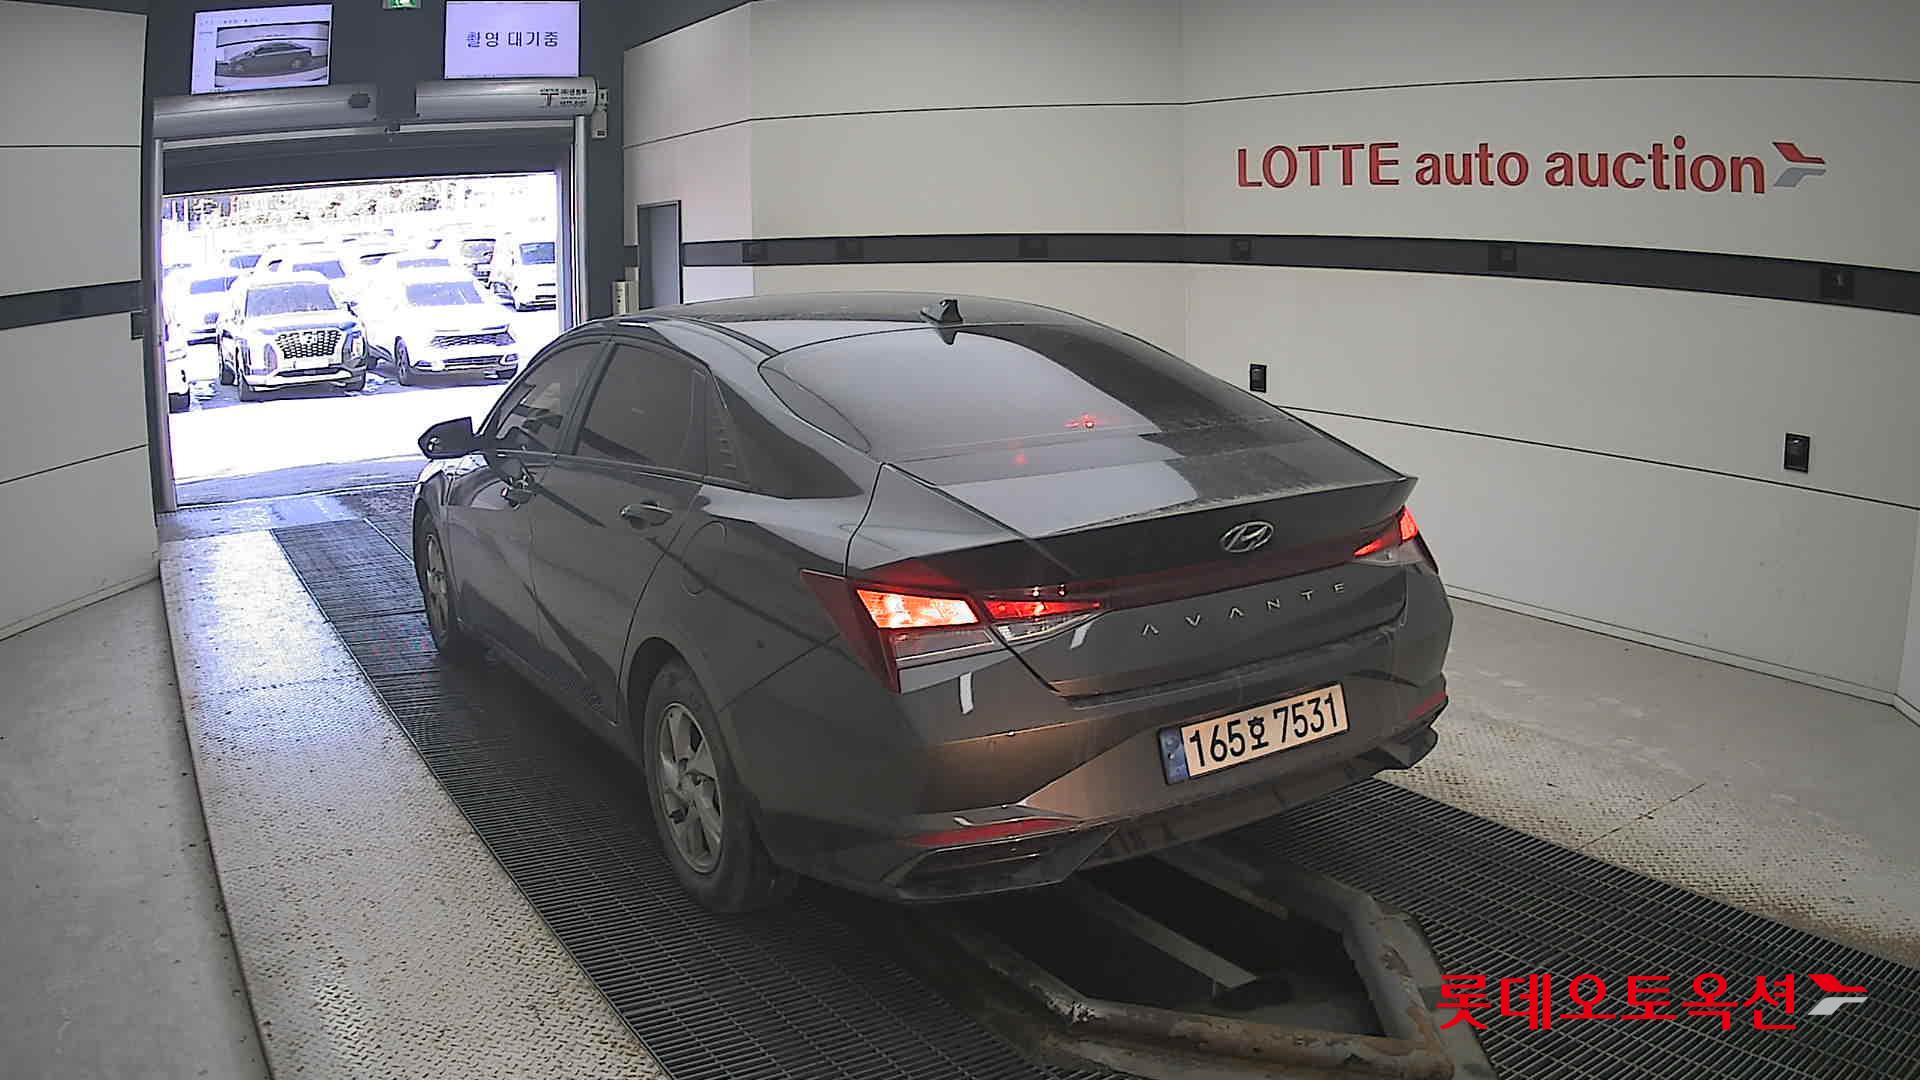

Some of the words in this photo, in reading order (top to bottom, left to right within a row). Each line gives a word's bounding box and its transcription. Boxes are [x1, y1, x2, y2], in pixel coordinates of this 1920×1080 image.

[508, 31, 559, 48] 대기중
[1237, 143, 1400, 188] LOTTE
[1415, 142, 1530, 187] auto
[1544, 135, 1766, 194] auction
[1140, 582, 1345, 638] AVANTE
[1272, 692, 1339, 744] 7531
